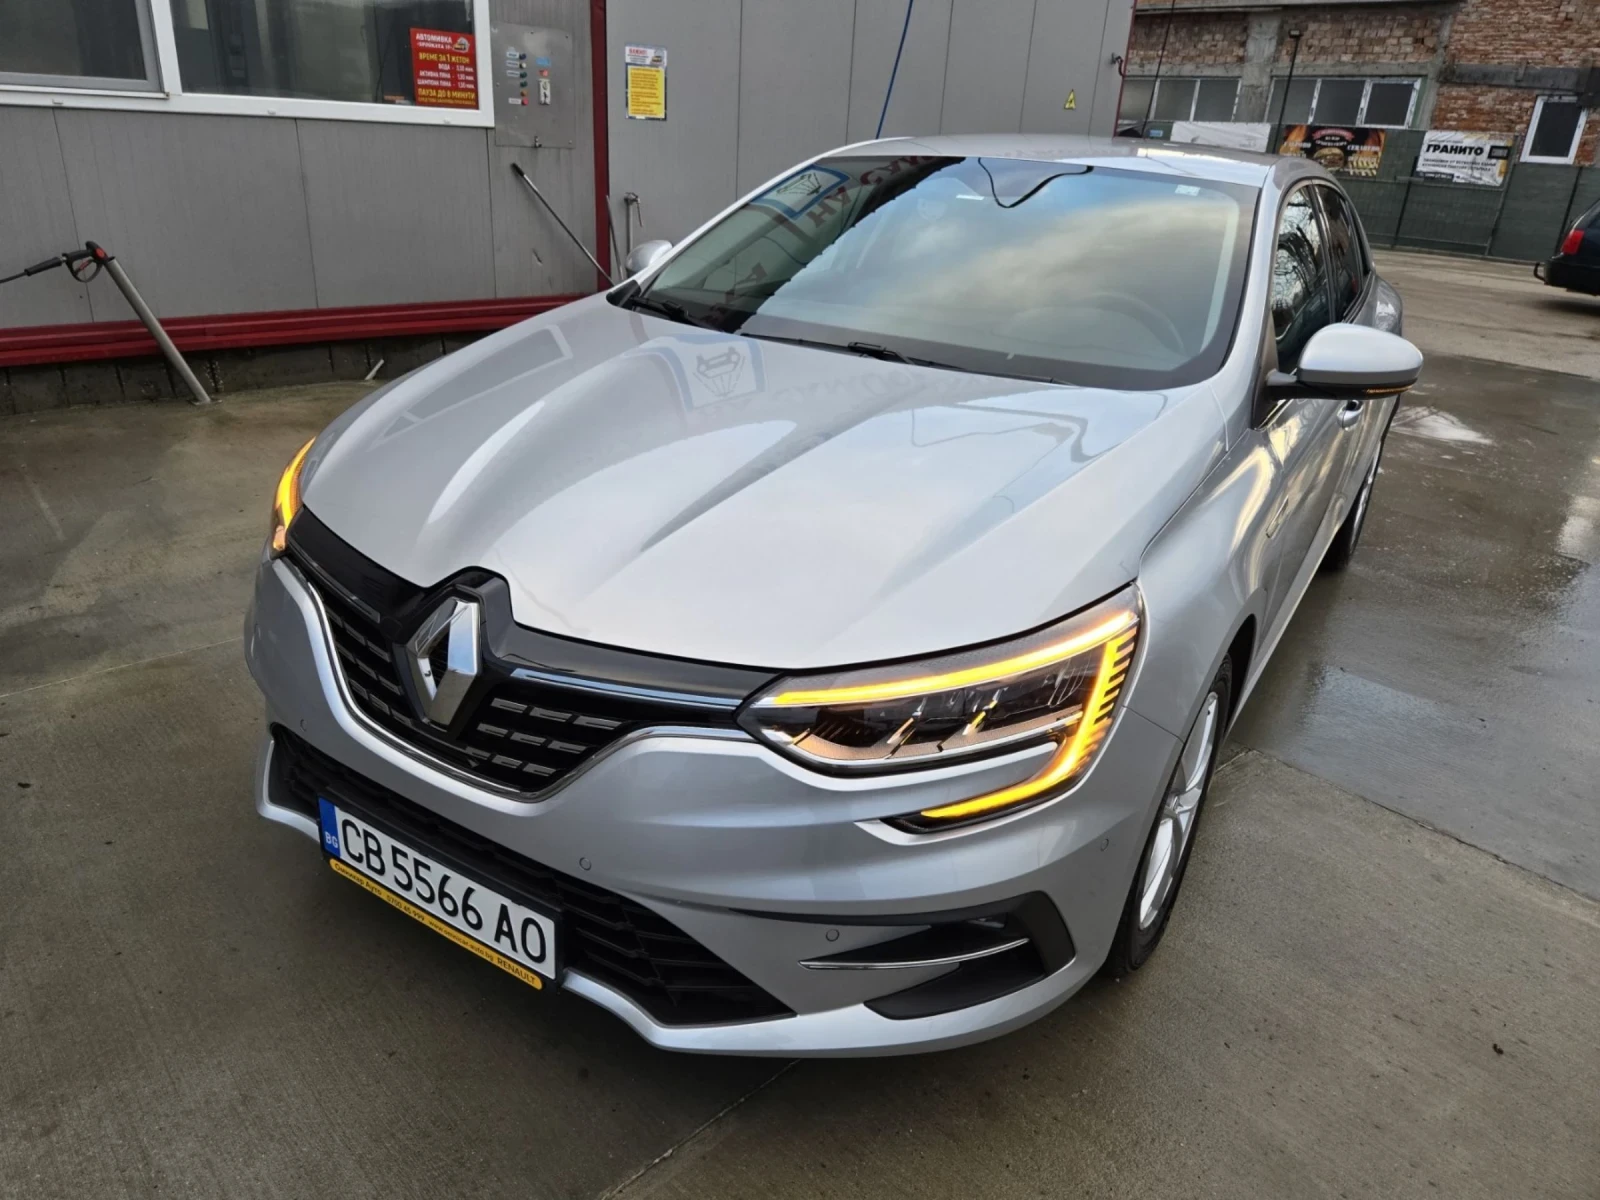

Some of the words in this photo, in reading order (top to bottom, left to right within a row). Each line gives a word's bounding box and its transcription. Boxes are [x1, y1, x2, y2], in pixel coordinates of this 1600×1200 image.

[416, 33, 452, 43] АВТОМИВКА
[1426, 144, 1484, 156] ГРАНИТО
[325, 831, 338, 849] BG
[341, 818, 386, 877] CB
[391, 844, 483, 931] 5566
[494, 903, 547, 964] AO
[497, 956, 535, 985] RENAULT
